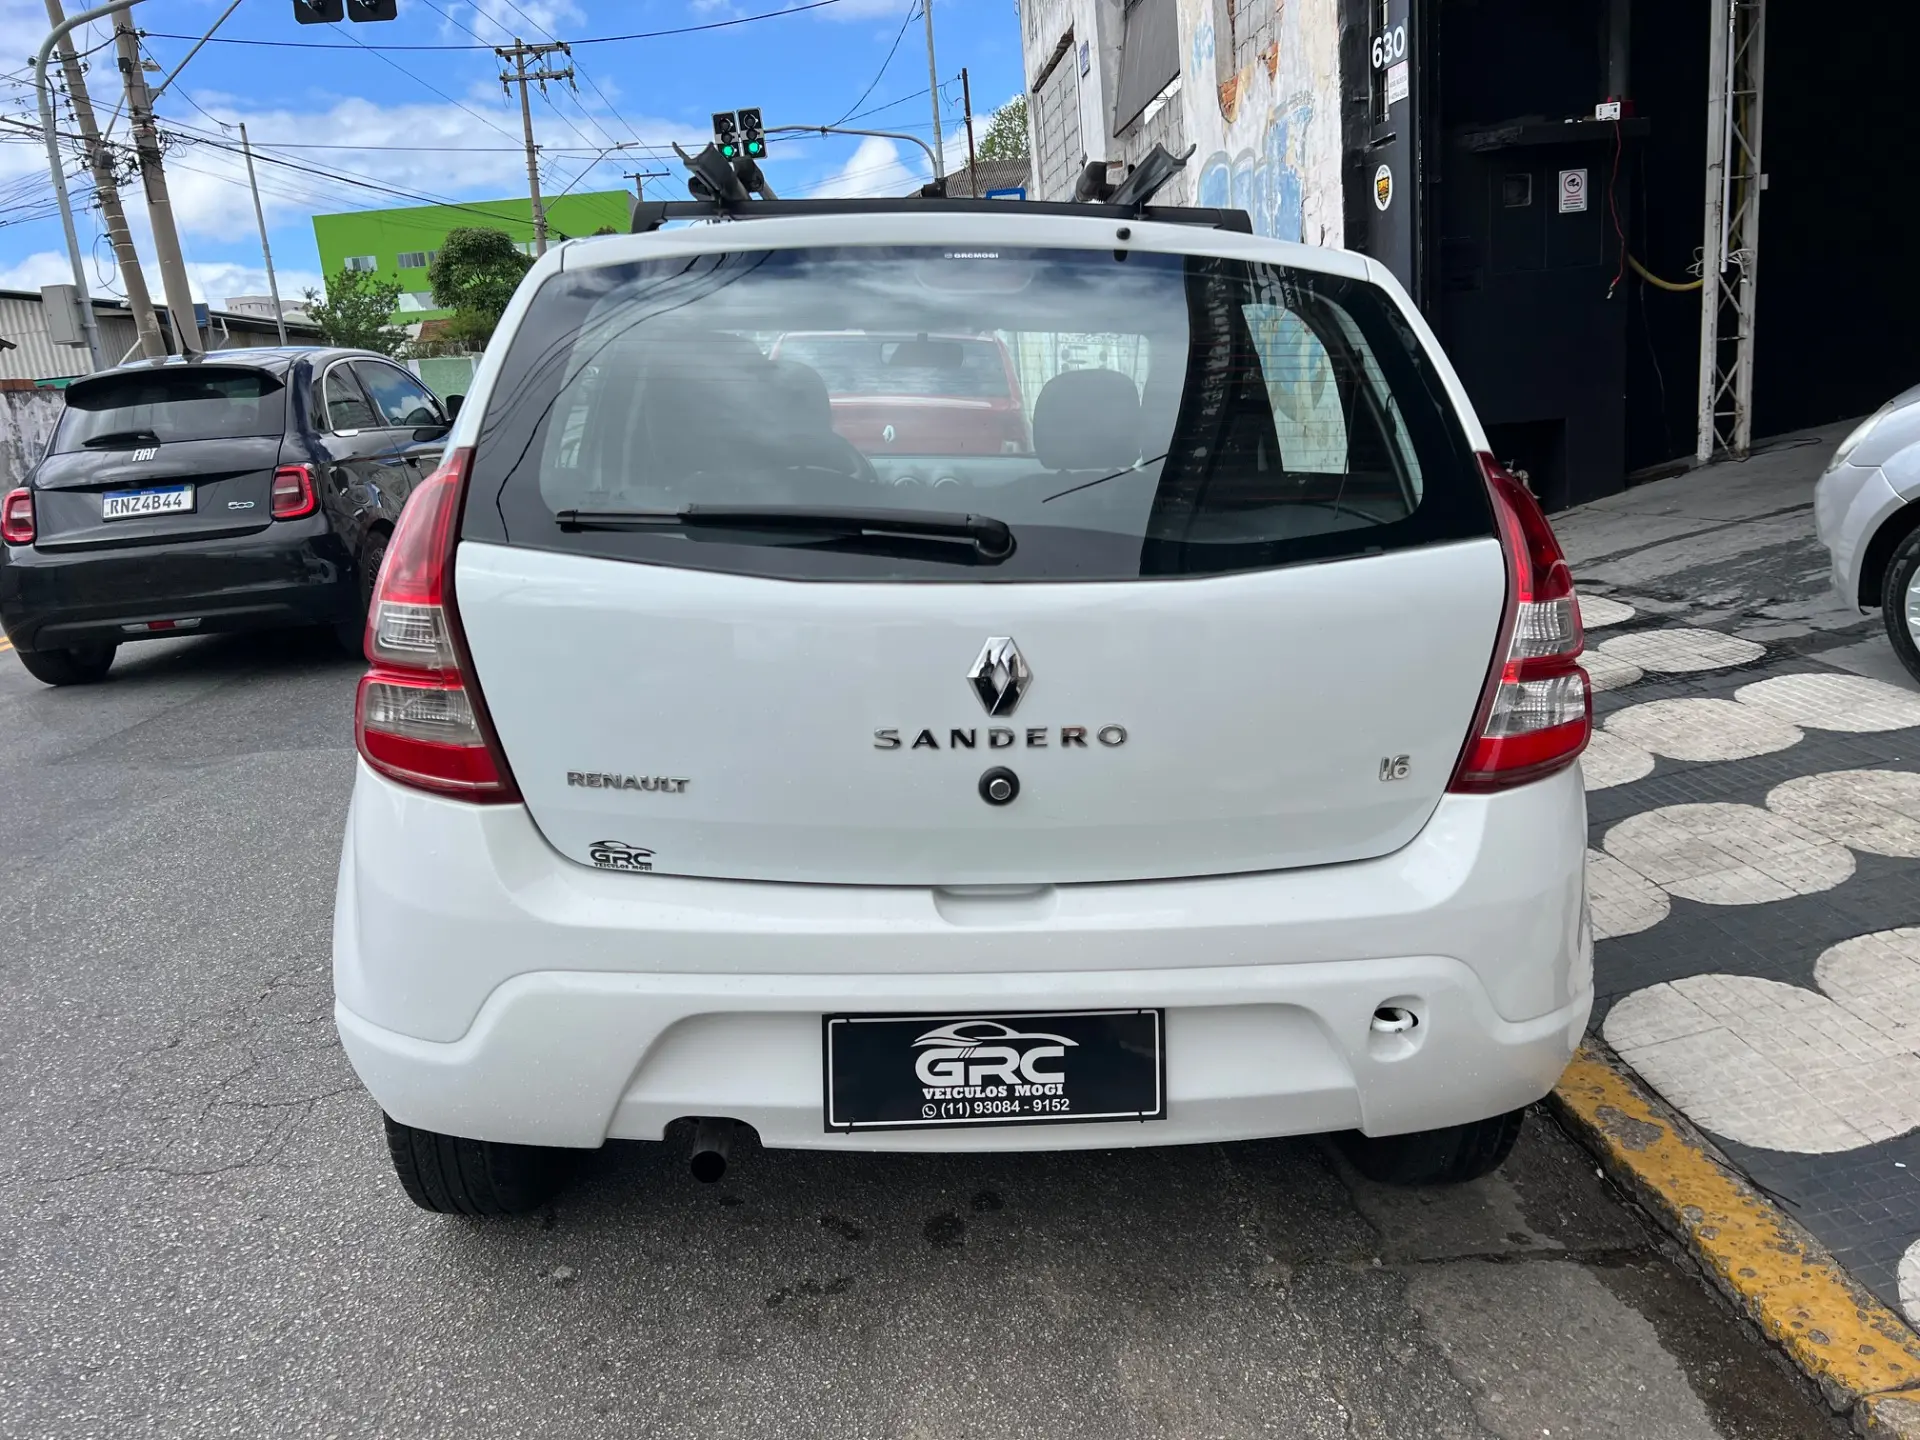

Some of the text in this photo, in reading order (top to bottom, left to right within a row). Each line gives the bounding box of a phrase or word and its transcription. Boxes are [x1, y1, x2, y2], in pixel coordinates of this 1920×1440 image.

[1372, 26, 1405, 68] 630
[132, 448, 158, 462] FIAT
[110, 493, 182, 515] RNZ4B44
[874, 723, 1128, 750] SANDERO
[567, 769, 690, 794] RENAULT
[590, 849, 653, 867] GRC
[915, 1046, 1065, 1087] GRC
[922, 1083, 1063, 1100] VEICULOS MOGI
[941, 1102, 970, 1118] (11)
[974, 1100, 1020, 1115] 93084
[1033, 1098, 1070, 1112] 9152
